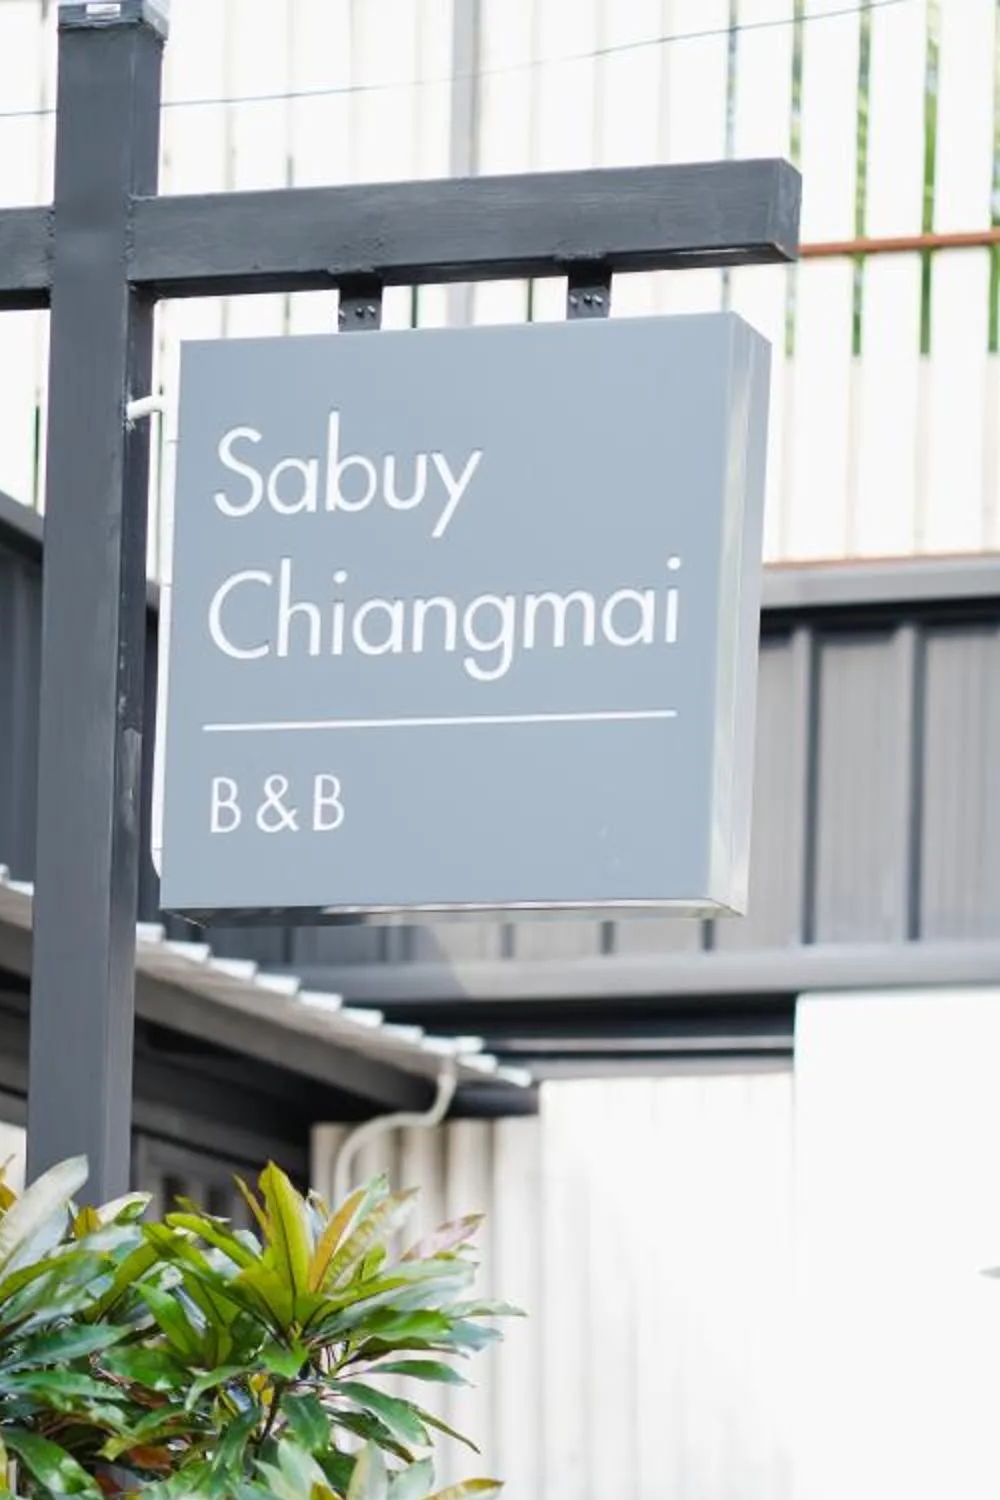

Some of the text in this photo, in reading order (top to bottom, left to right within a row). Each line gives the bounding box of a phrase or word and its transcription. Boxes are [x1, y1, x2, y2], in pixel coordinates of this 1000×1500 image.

[213, 411, 485, 539] Sabuy
[207, 556, 682, 682] Chiangmai
[209, 773, 346, 834] B&B
